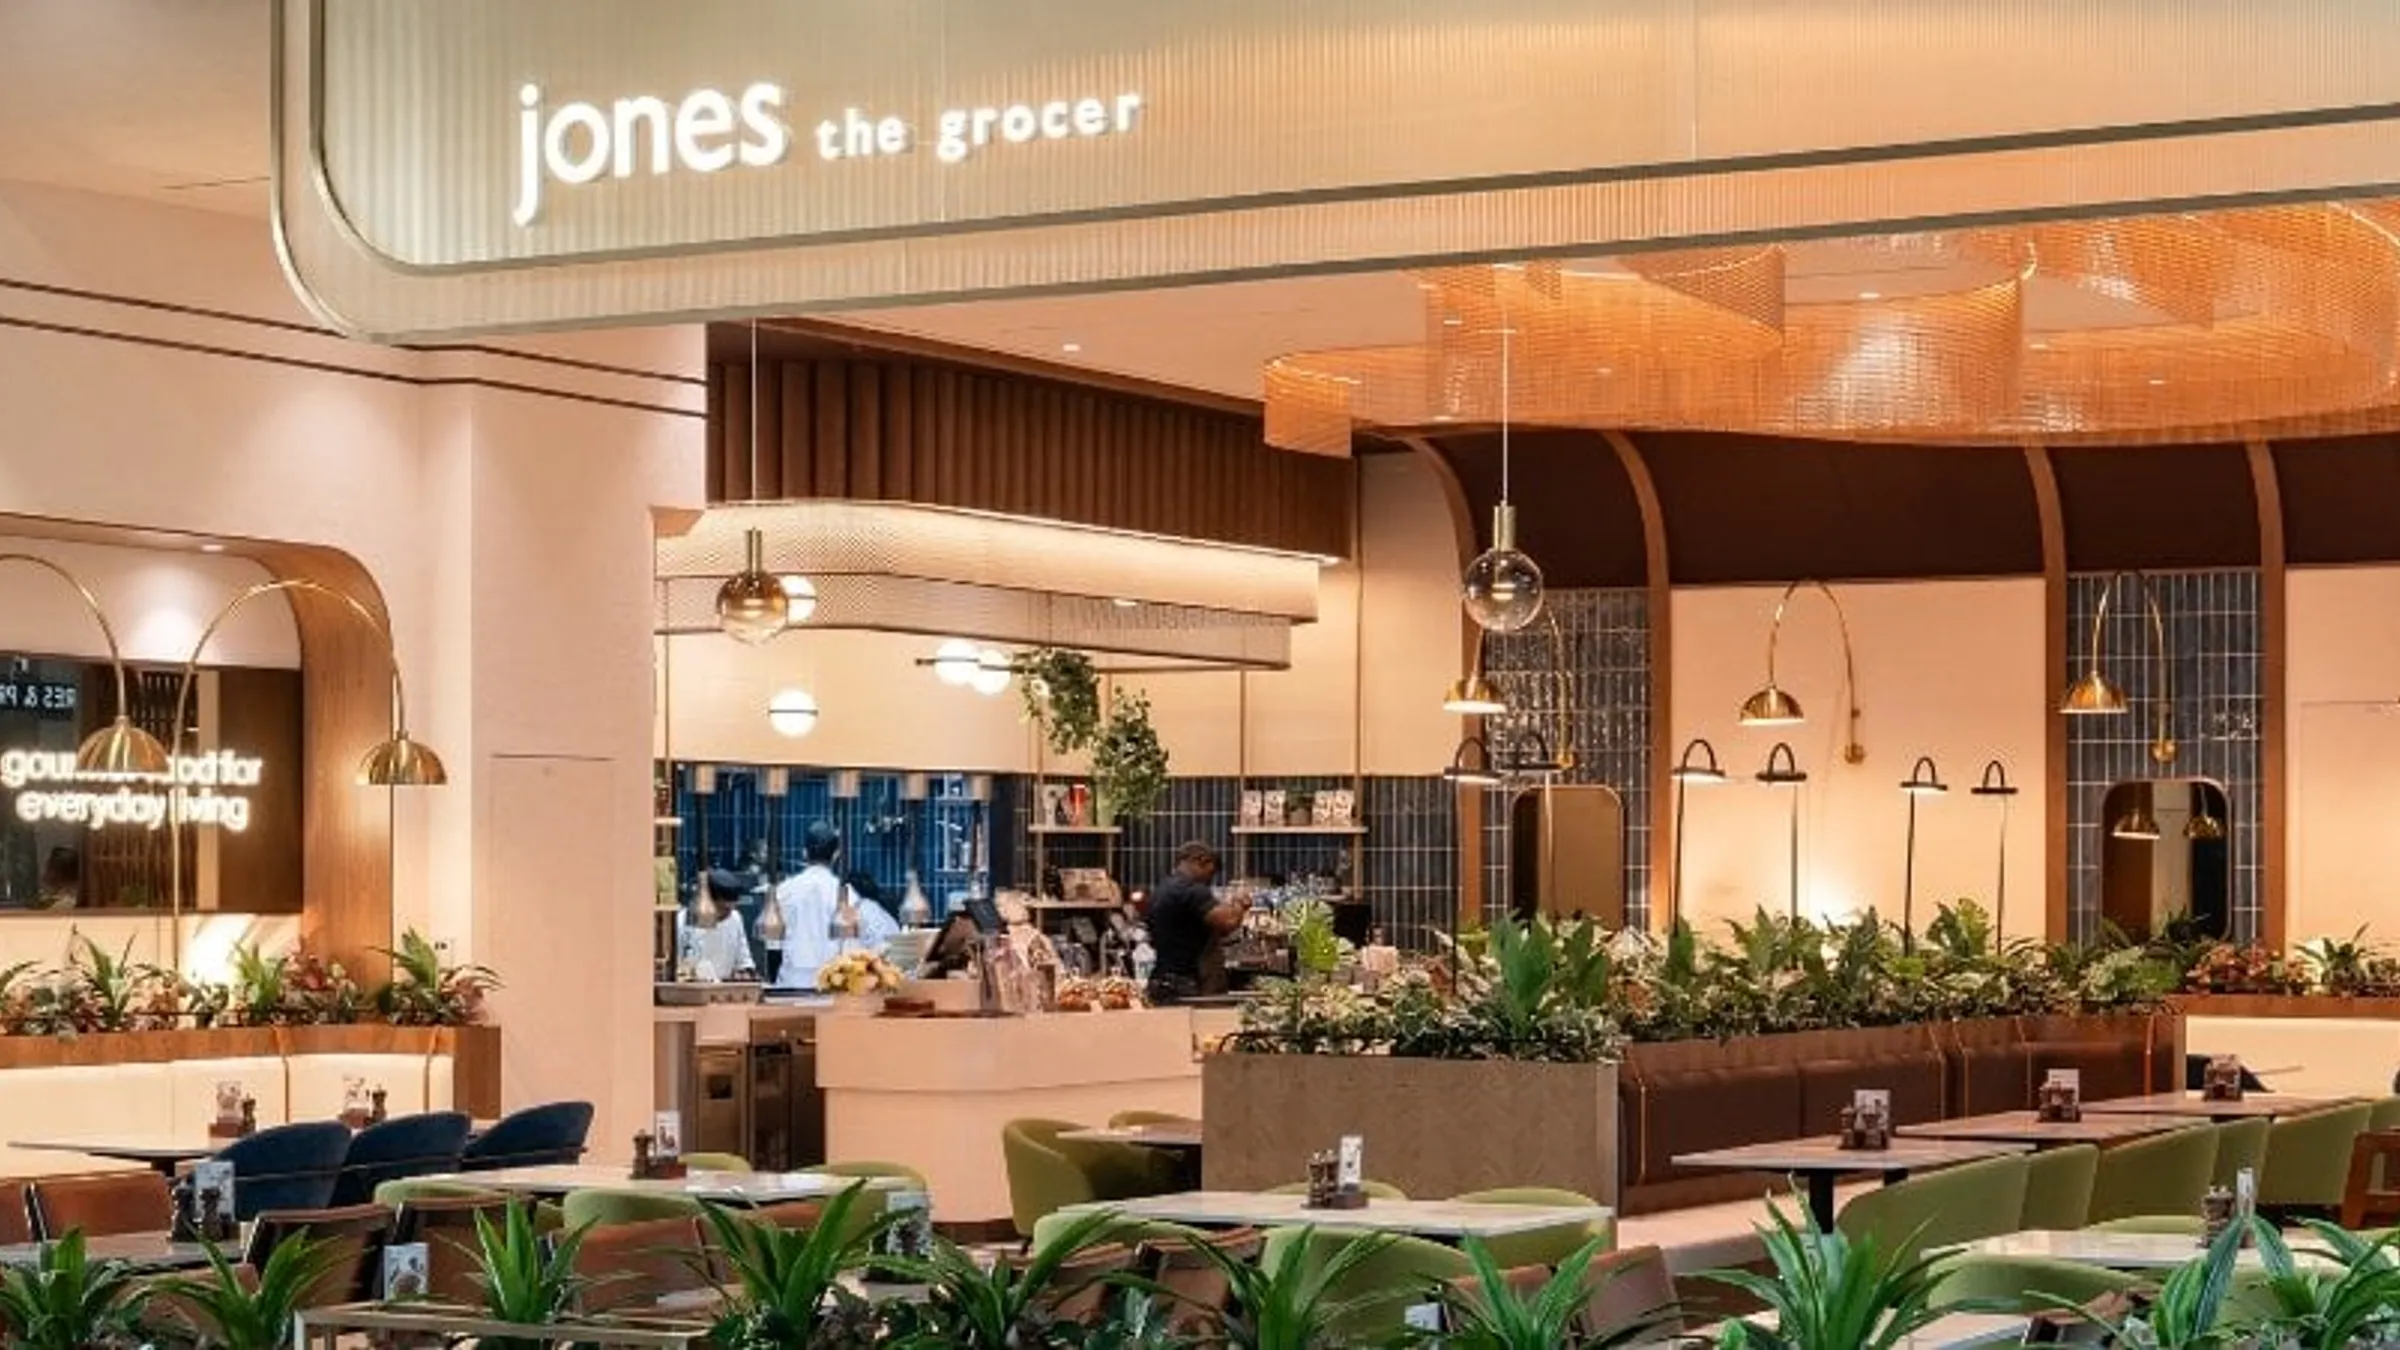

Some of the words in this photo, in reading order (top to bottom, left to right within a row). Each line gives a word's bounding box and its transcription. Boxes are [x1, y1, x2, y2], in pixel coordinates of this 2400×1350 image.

[513, 82, 787, 227] jones
[815, 109, 909, 160] the
[936, 93, 1142, 163] grocer
[220, 749, 262, 785] for
[16, 786, 166, 830] everyday
[168, 786, 249, 832] living
